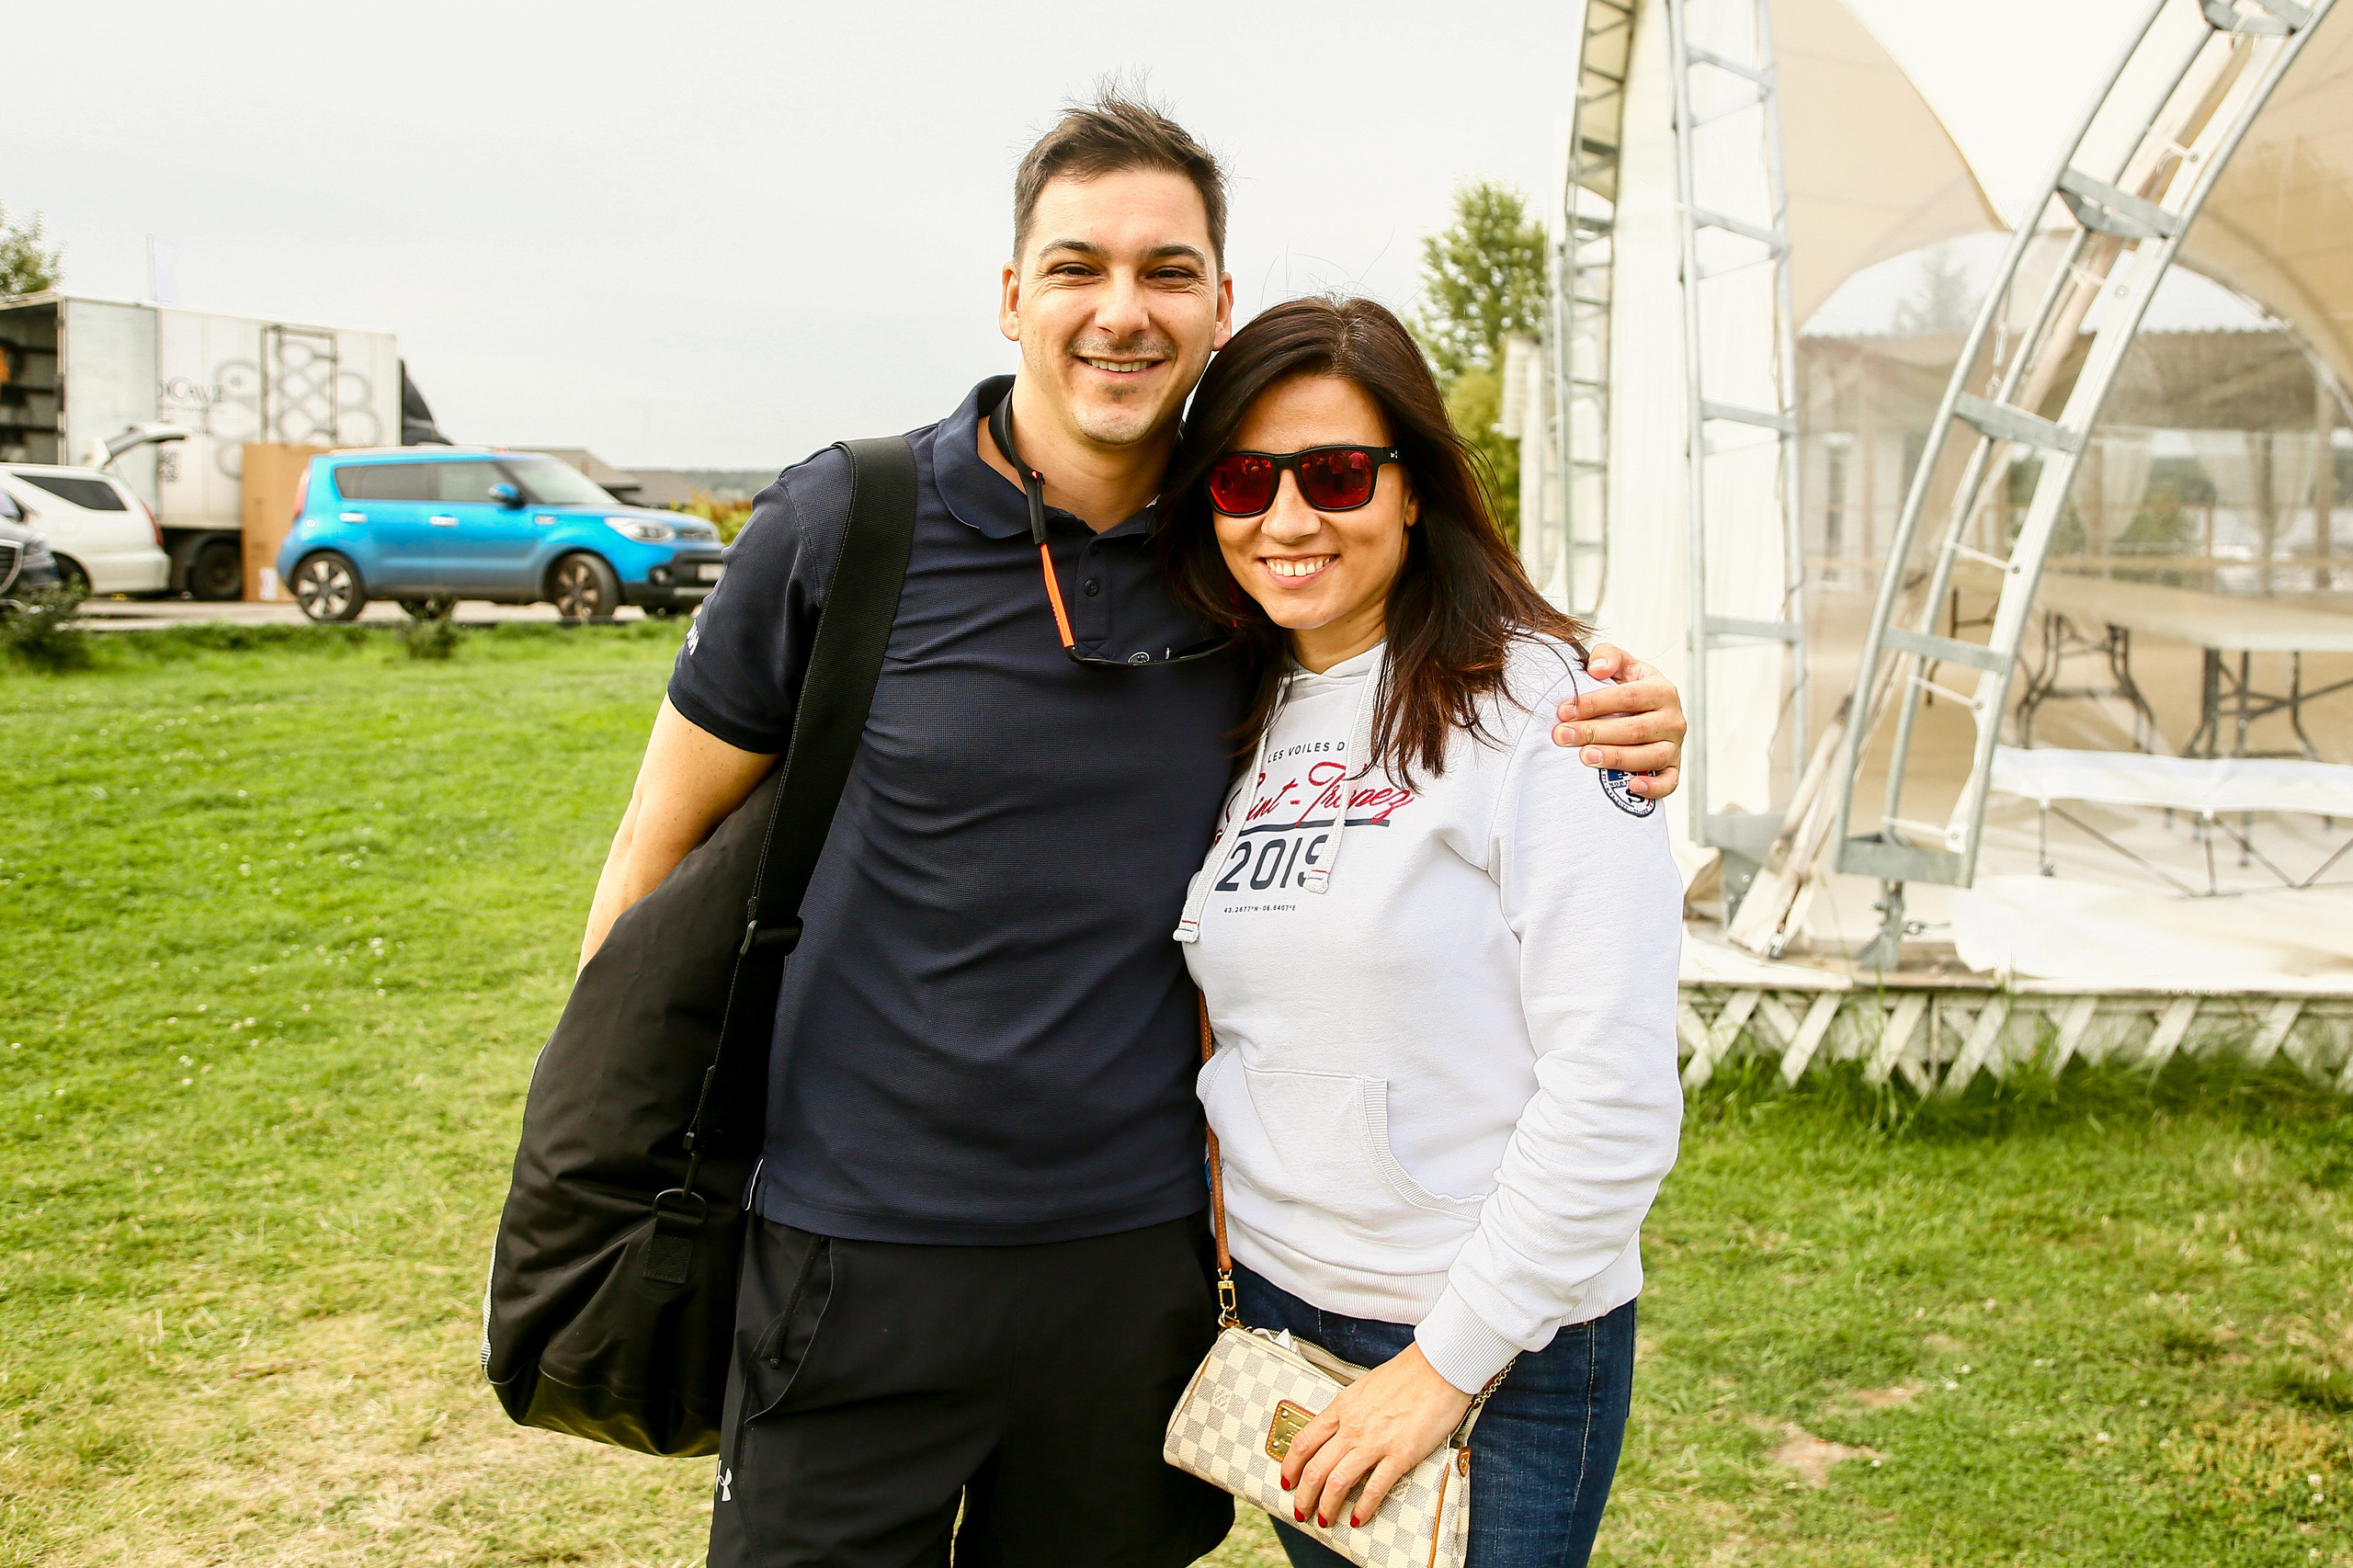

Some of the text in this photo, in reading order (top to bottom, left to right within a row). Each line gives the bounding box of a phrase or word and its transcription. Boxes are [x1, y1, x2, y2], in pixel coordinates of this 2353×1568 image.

[1267, 741, 1346, 763] LES VOILES D
